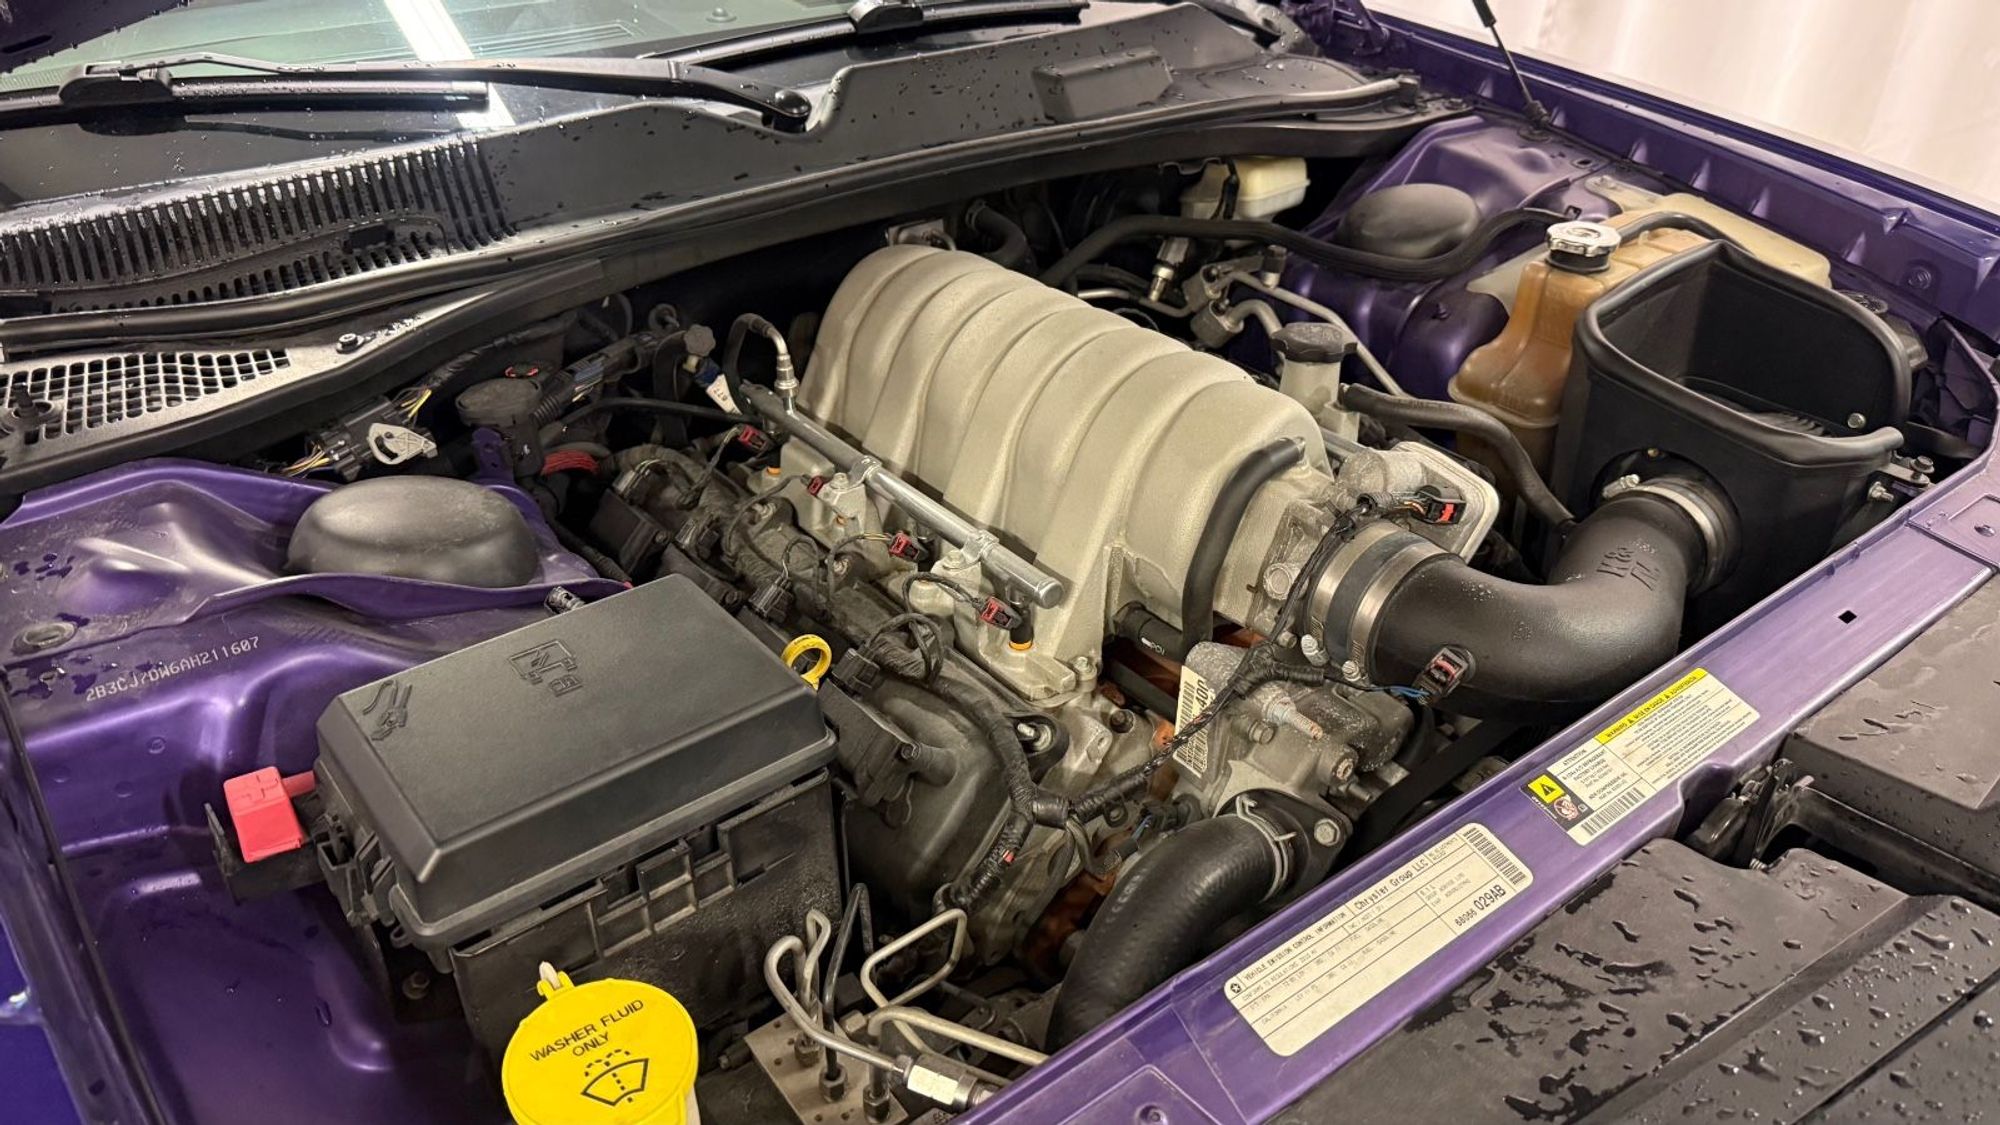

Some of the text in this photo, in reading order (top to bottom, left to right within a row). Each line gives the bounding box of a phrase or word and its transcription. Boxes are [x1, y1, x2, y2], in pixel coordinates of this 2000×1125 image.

[1353, 858, 1429, 912] Chrysler Group LLC
[1471, 883, 1507, 911] 029AB
[1292, 932, 1314, 949] CONTROL
[1314, 910, 1346, 934] INFORMATION
[530, 999, 645, 1062] WASHER FLUID
[572, 1031, 610, 1057] ONLY
